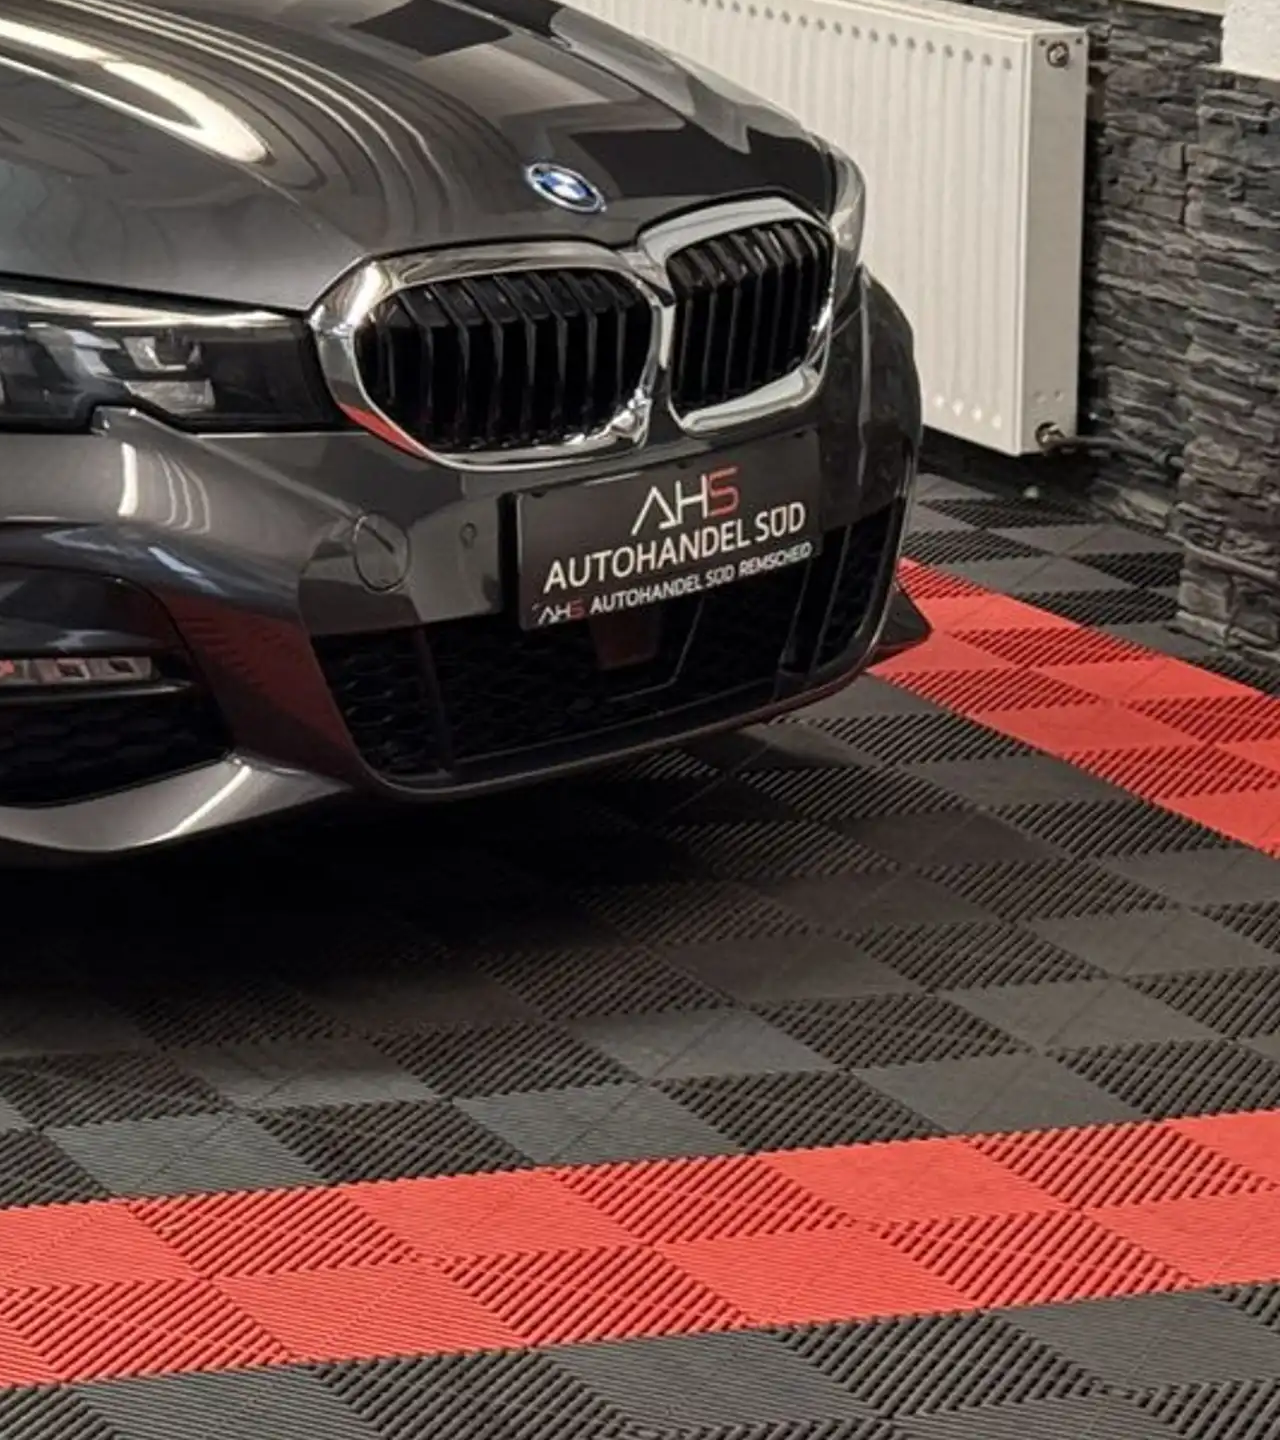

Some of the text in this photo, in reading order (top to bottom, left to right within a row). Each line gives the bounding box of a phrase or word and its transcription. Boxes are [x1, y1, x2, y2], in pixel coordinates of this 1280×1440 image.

[630, 466, 740, 536] AHS
[542, 501, 807, 594] AUTOHANDEL SÜD
[589, 573, 703, 615] AUTOHANDEL
